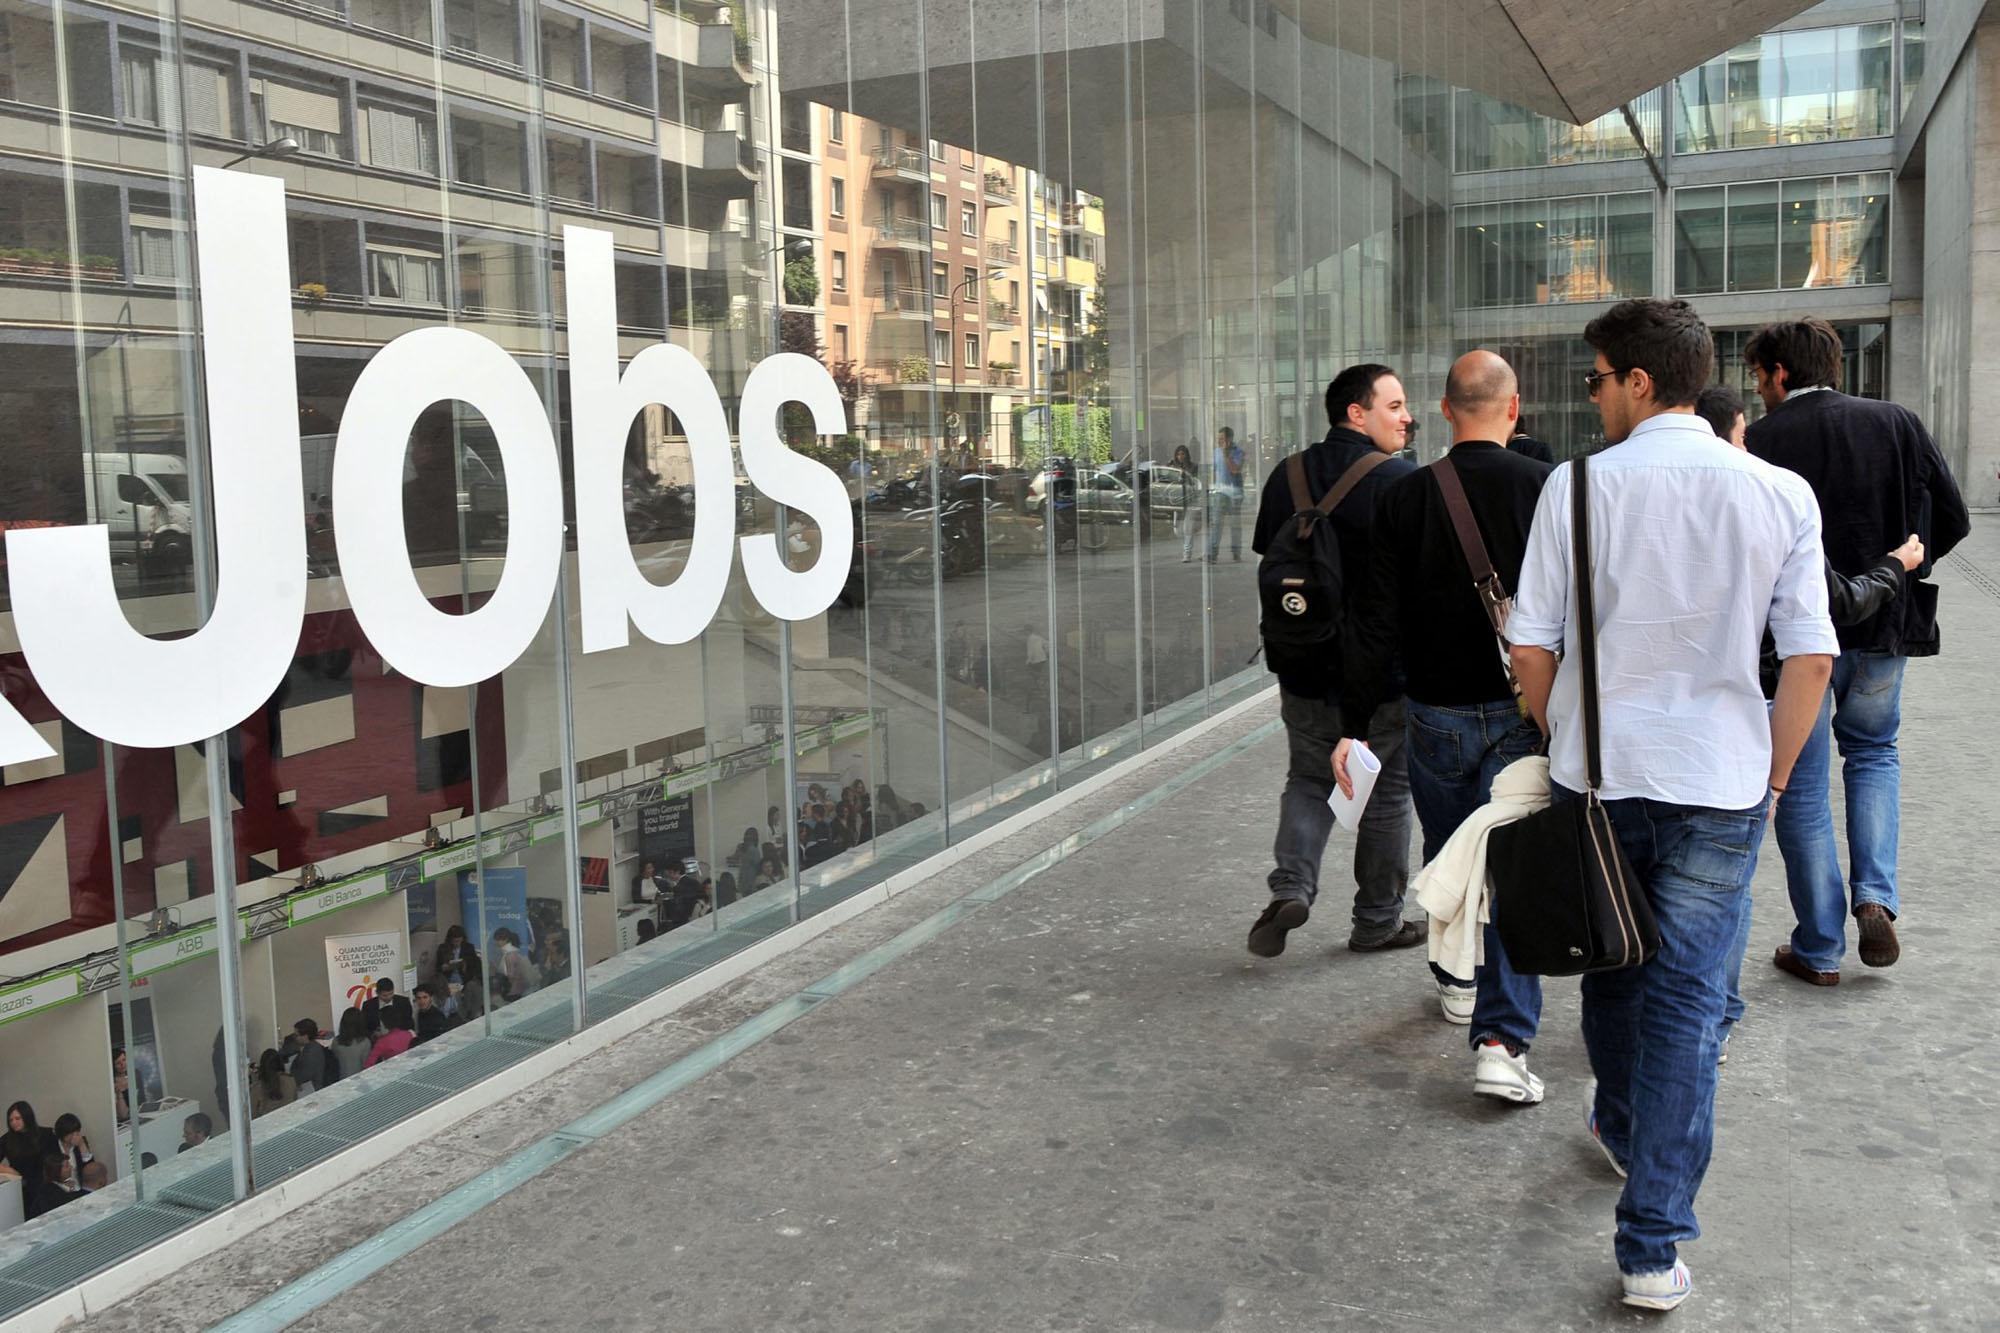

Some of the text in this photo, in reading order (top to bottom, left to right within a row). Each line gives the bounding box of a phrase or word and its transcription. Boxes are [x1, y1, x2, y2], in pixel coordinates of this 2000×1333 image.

[644, 817, 658, 825] you
[644, 821, 679, 834] the world
[318, 887, 362, 908] UBI Banca
[176, 936, 204, 955] ABB
[338, 943, 389, 955] QUANDO UNA
[334, 953, 360, 962] SCELTA
[369, 949, 395, 958] GIUSTA
[351, 957, 390, 967] RICONOSCI
[0, 995, 33, 1014] azars
